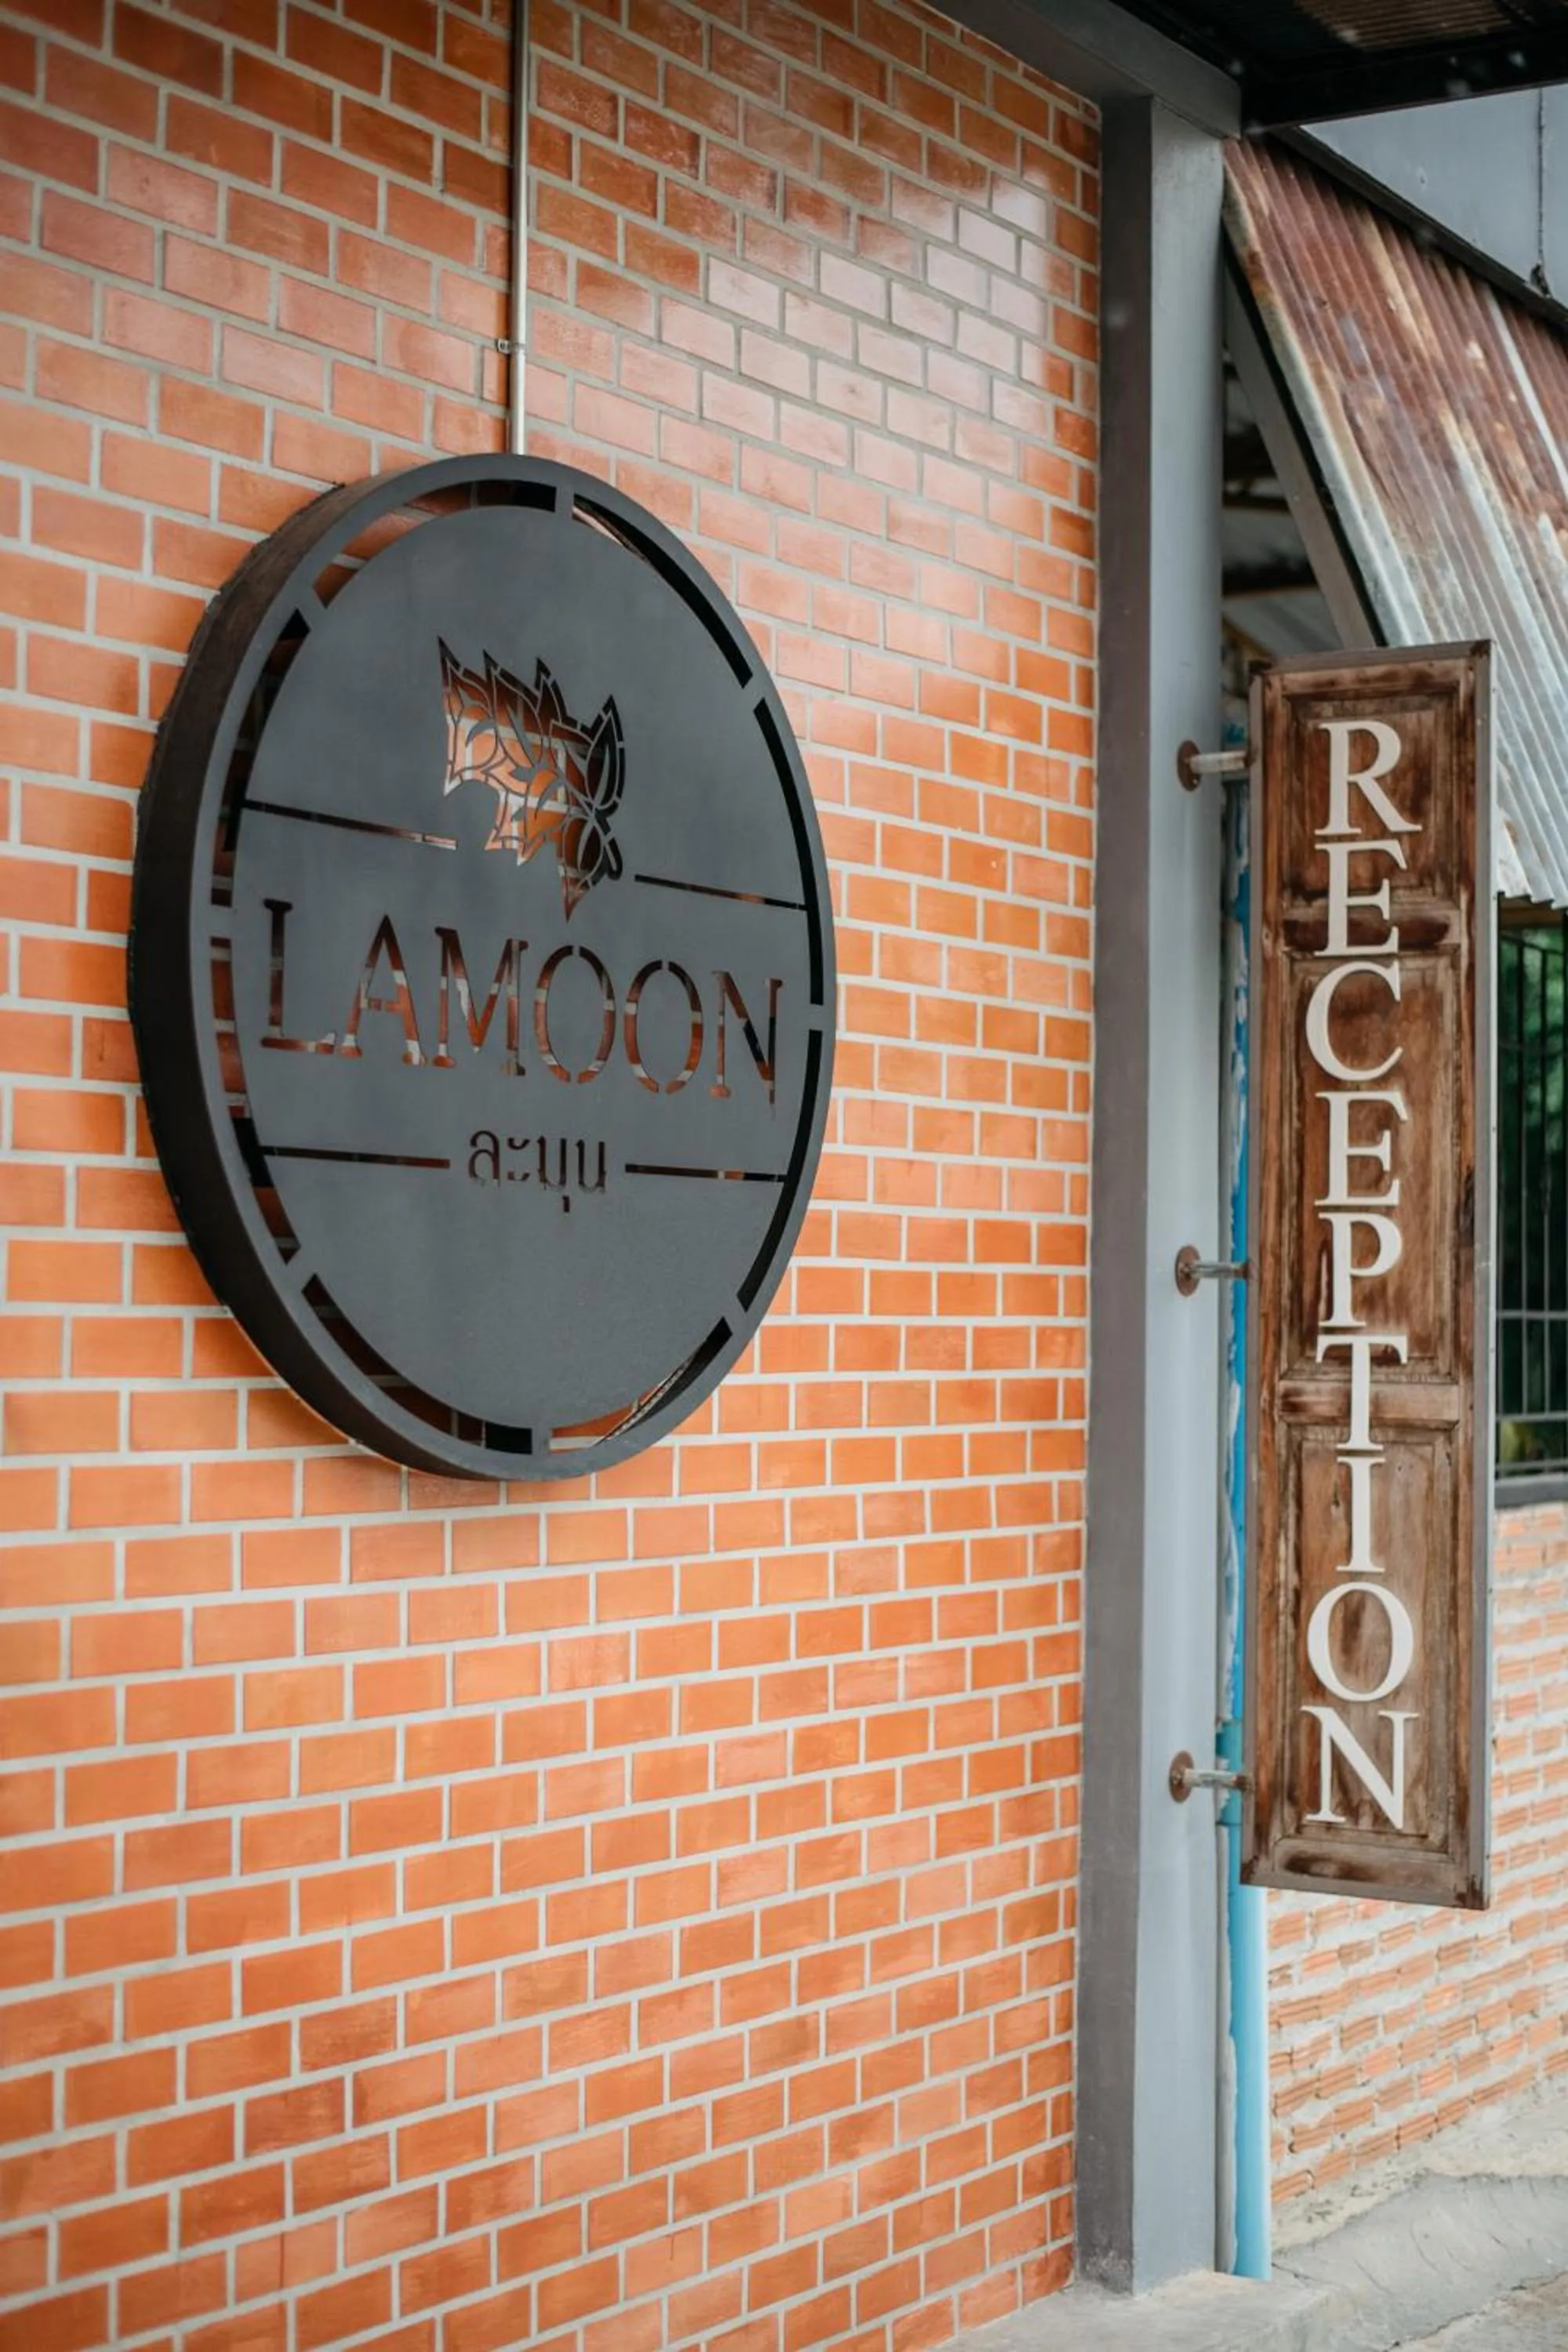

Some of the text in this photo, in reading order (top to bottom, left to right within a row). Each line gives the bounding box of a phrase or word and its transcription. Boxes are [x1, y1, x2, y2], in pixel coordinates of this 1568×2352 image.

[261, 898, 782, 1107] LAMOON
[468, 1130, 606, 1214] ละมุน
[1299, 720, 1423, 1831] RECEPTION
